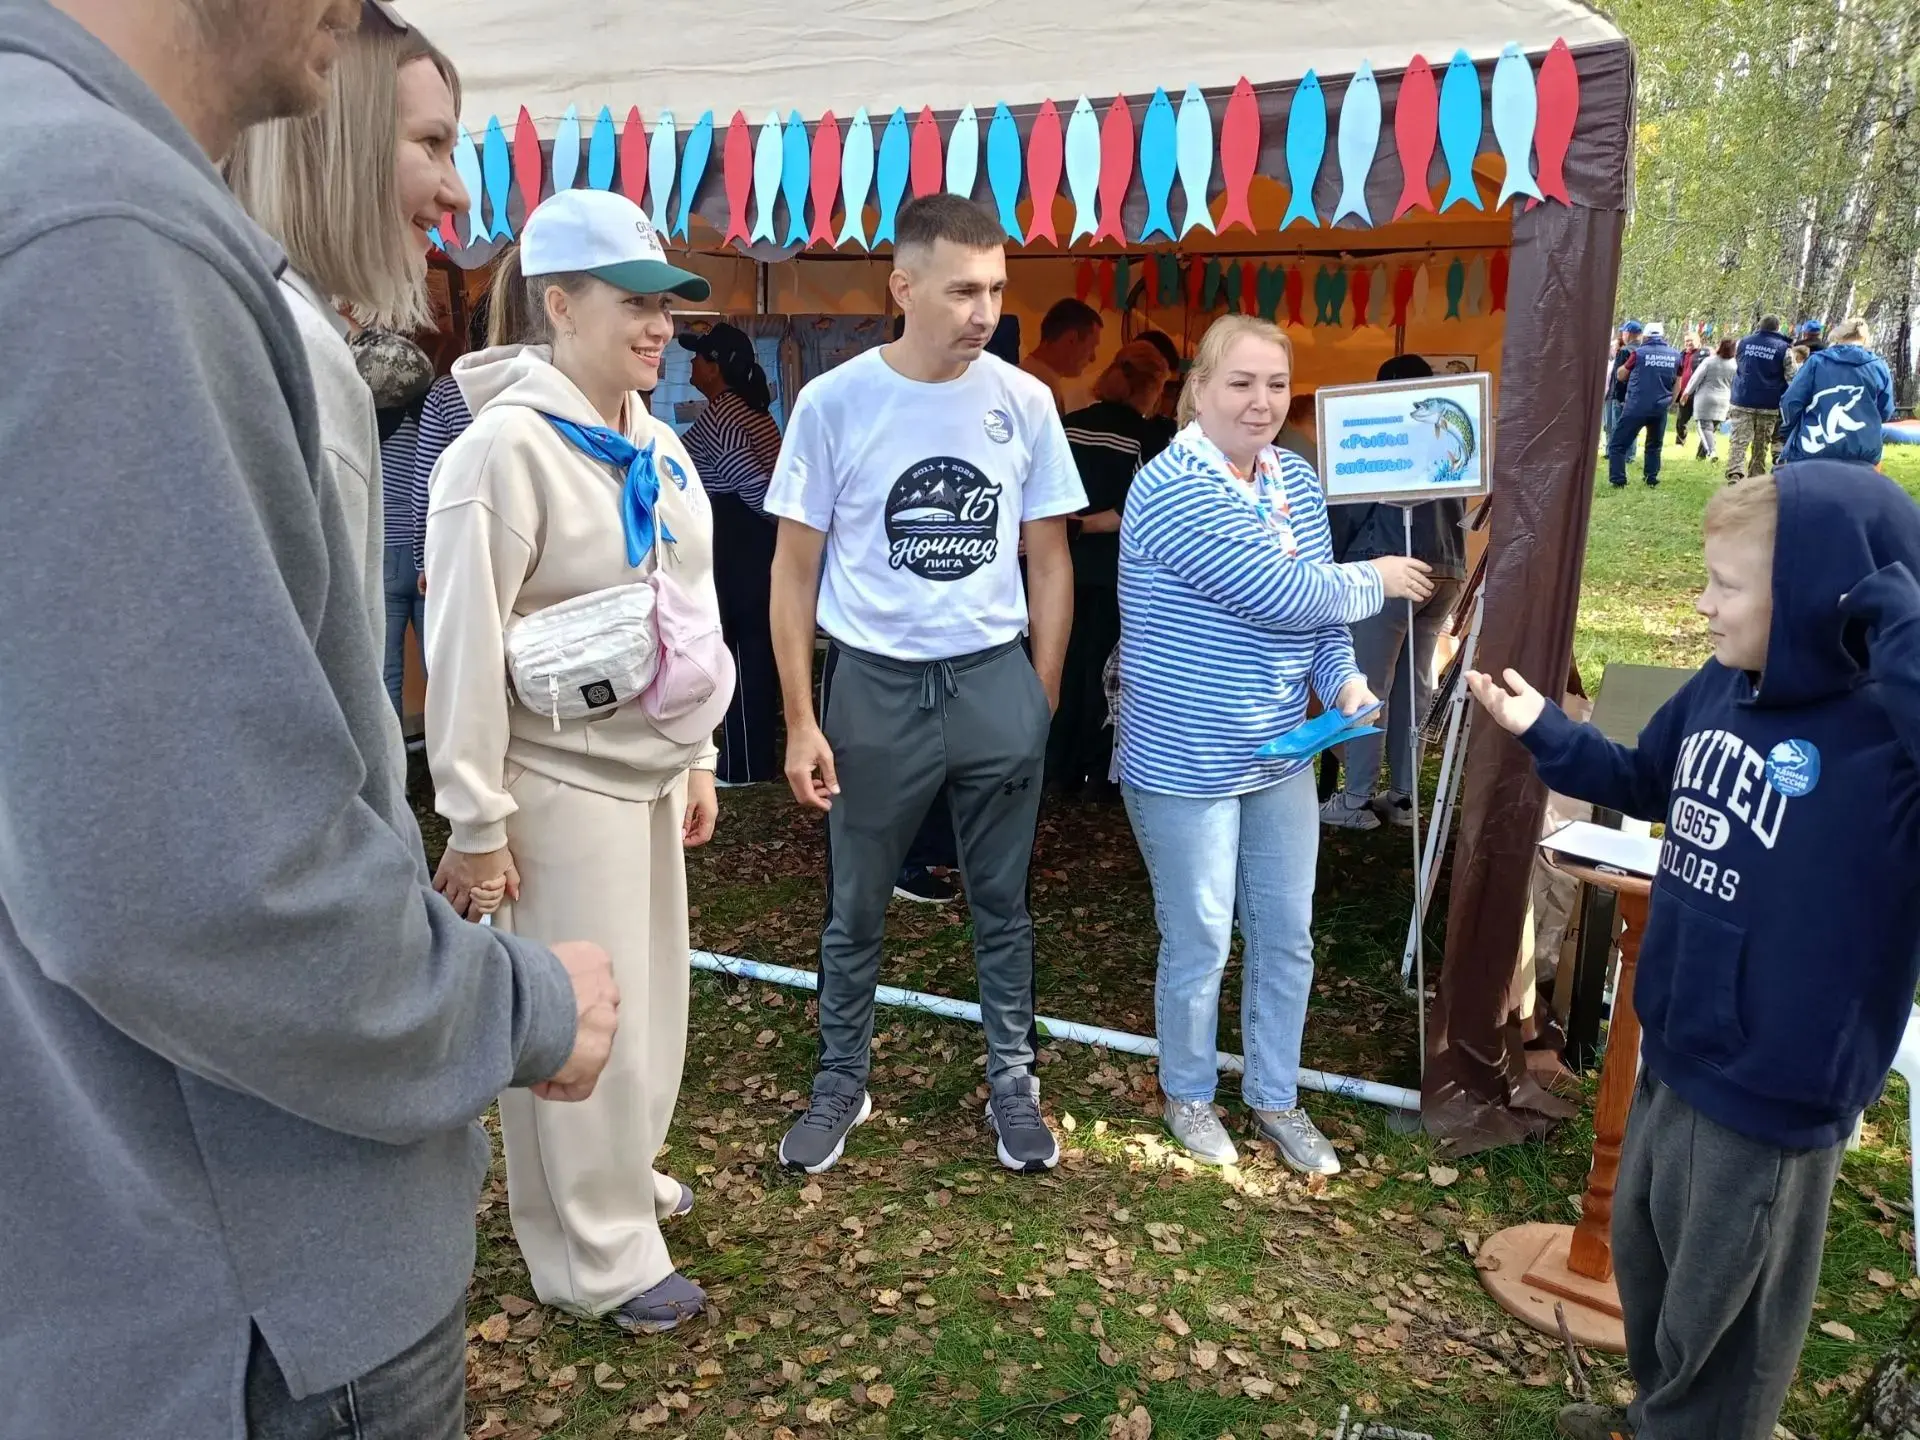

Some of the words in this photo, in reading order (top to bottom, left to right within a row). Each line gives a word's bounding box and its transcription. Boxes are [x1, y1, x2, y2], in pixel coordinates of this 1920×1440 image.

[1745, 344, 1776, 354] ЕДИНАЯ
[1745, 350, 1774, 360] РОССИЯ
[1645, 354, 1676, 362] ЕДИНАЯ
[1645, 360, 1675, 368] РОССИЯ
[912, 464, 936, 479] 2011
[959, 486, 1001, 522] 15
[891, 536, 997, 568] Ночная
[924, 558, 964, 568] ЛИГА
[1773, 773, 1807, 790] РОССИЯ
[1776, 767, 1809, 783] ЕДИНАЯ
[1671, 729, 1788, 850] NITED
[1675, 801, 1721, 845] 1965
[1660, 839, 1740, 902] OLORS
